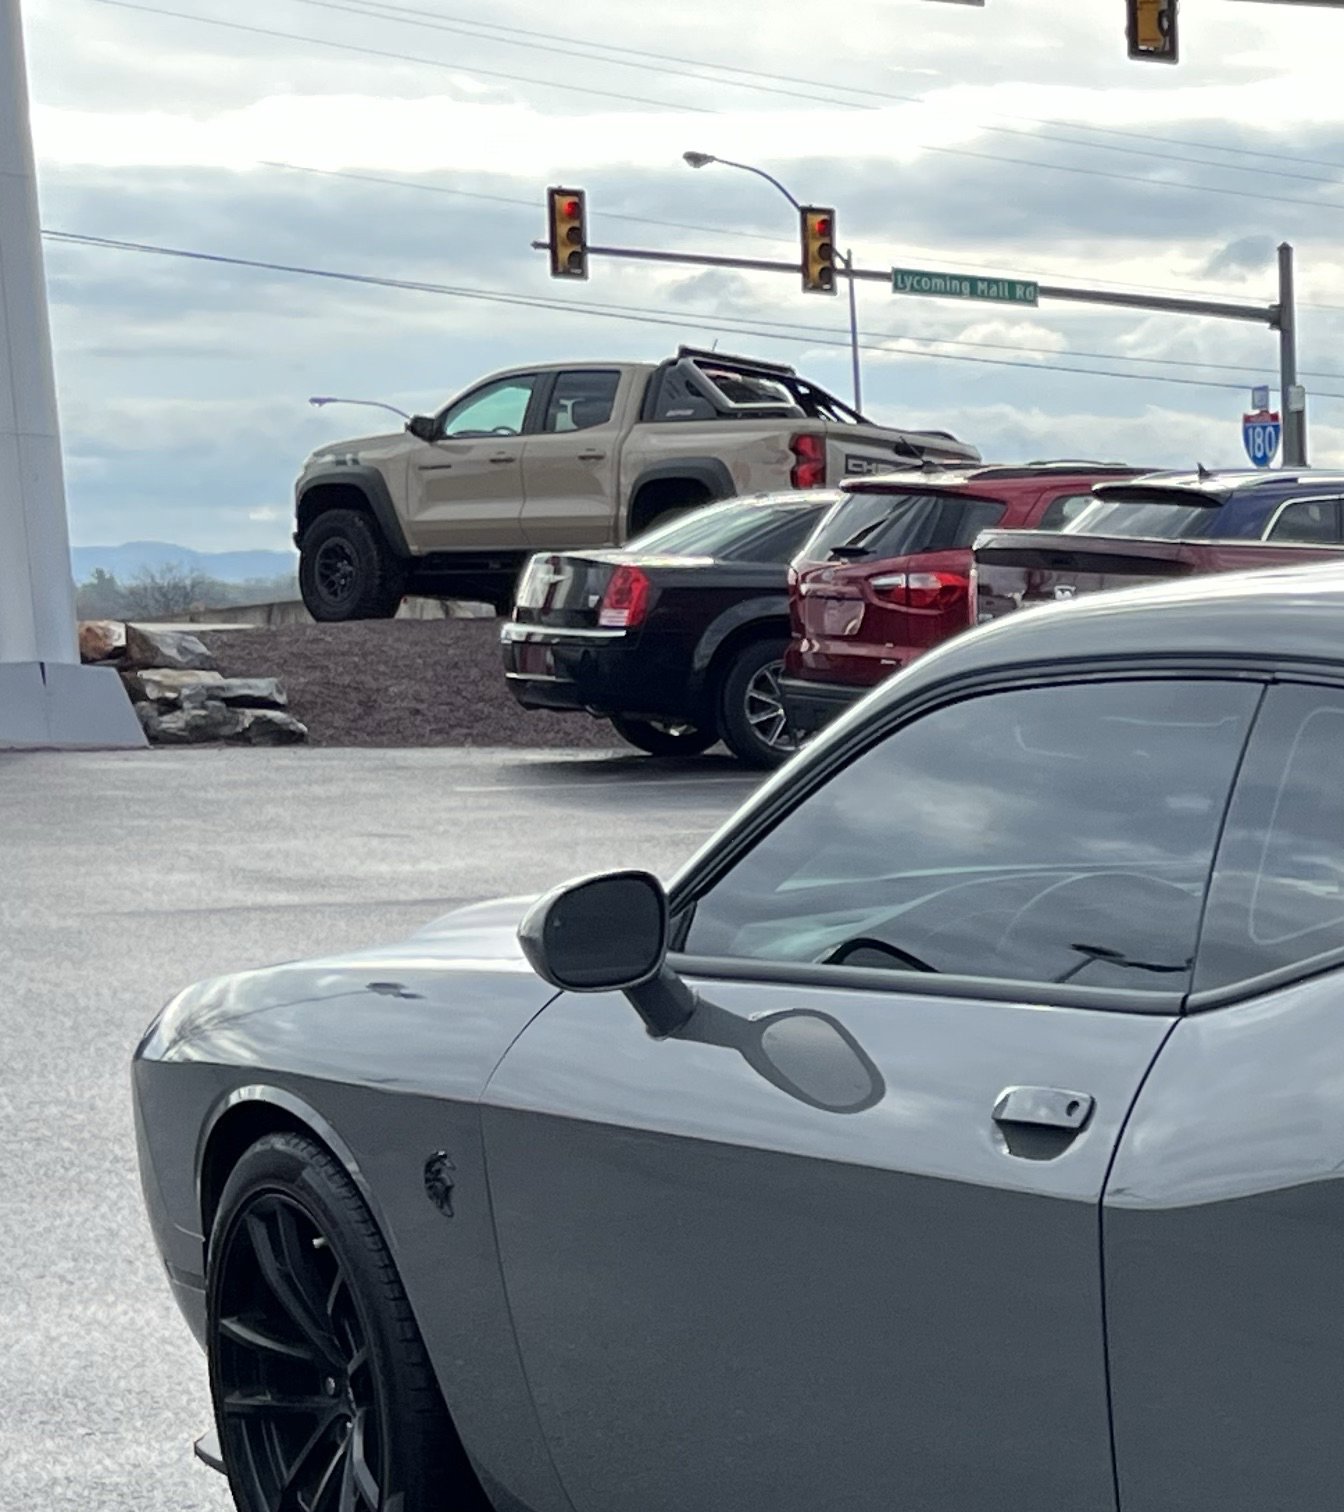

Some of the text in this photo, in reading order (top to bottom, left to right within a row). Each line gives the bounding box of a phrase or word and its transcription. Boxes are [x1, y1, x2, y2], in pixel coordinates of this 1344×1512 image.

[896, 272, 1035, 301] Lycoming Mall Rd
[1247, 425, 1277, 459] 180
